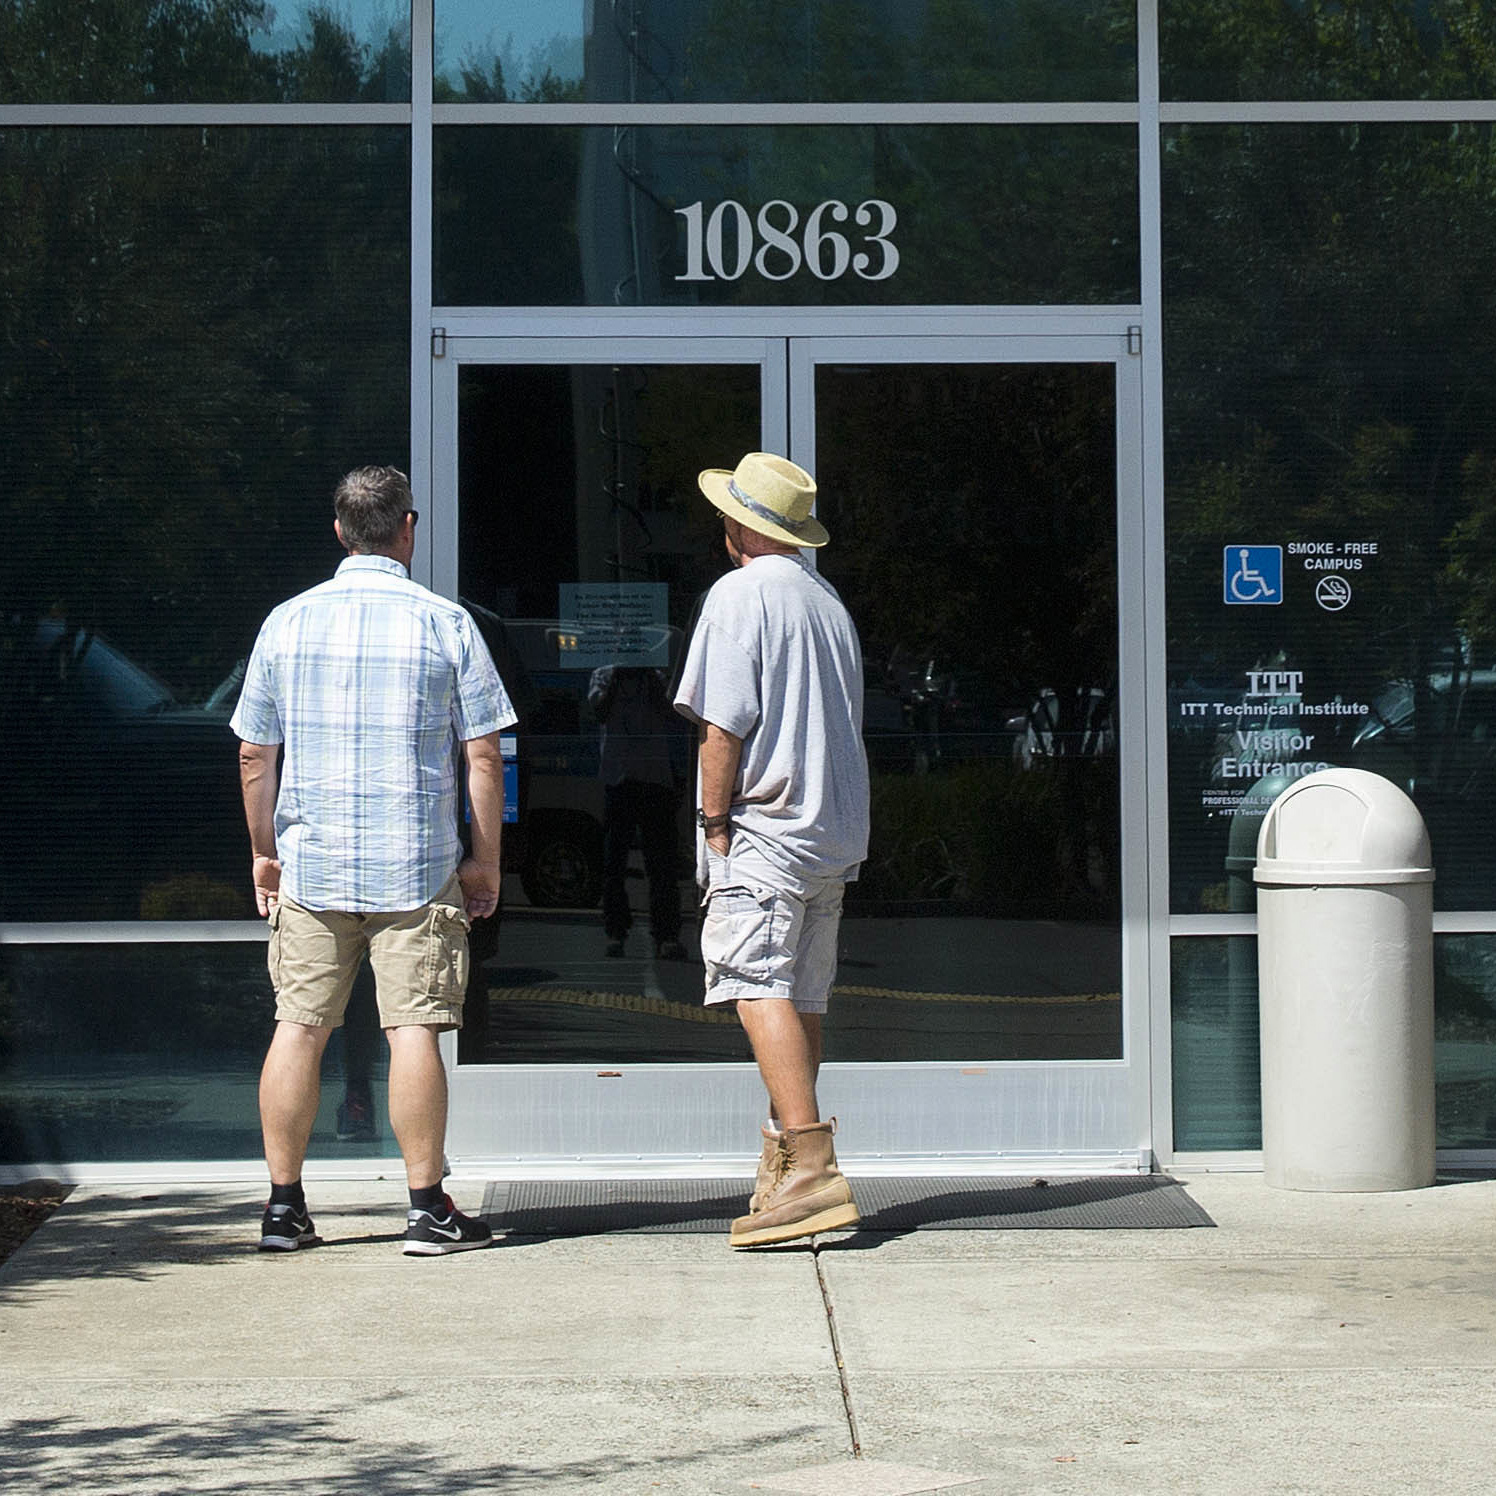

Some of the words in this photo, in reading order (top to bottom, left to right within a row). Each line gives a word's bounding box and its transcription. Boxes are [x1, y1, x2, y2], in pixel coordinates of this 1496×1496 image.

[673, 199, 901, 281] 10863
[1287, 542, 1334, 554] SMOKE
[1344, 543, 1378, 554] FREE
[1304, 558, 1363, 570] CAMPUS
[1245, 671, 1303, 697] ITT
[1180, 703, 1209, 716] ITT
[1213, 702, 1294, 716] Technical
[1299, 702, 1370, 716] Institute
[1236, 730, 1315, 751] Visitor
